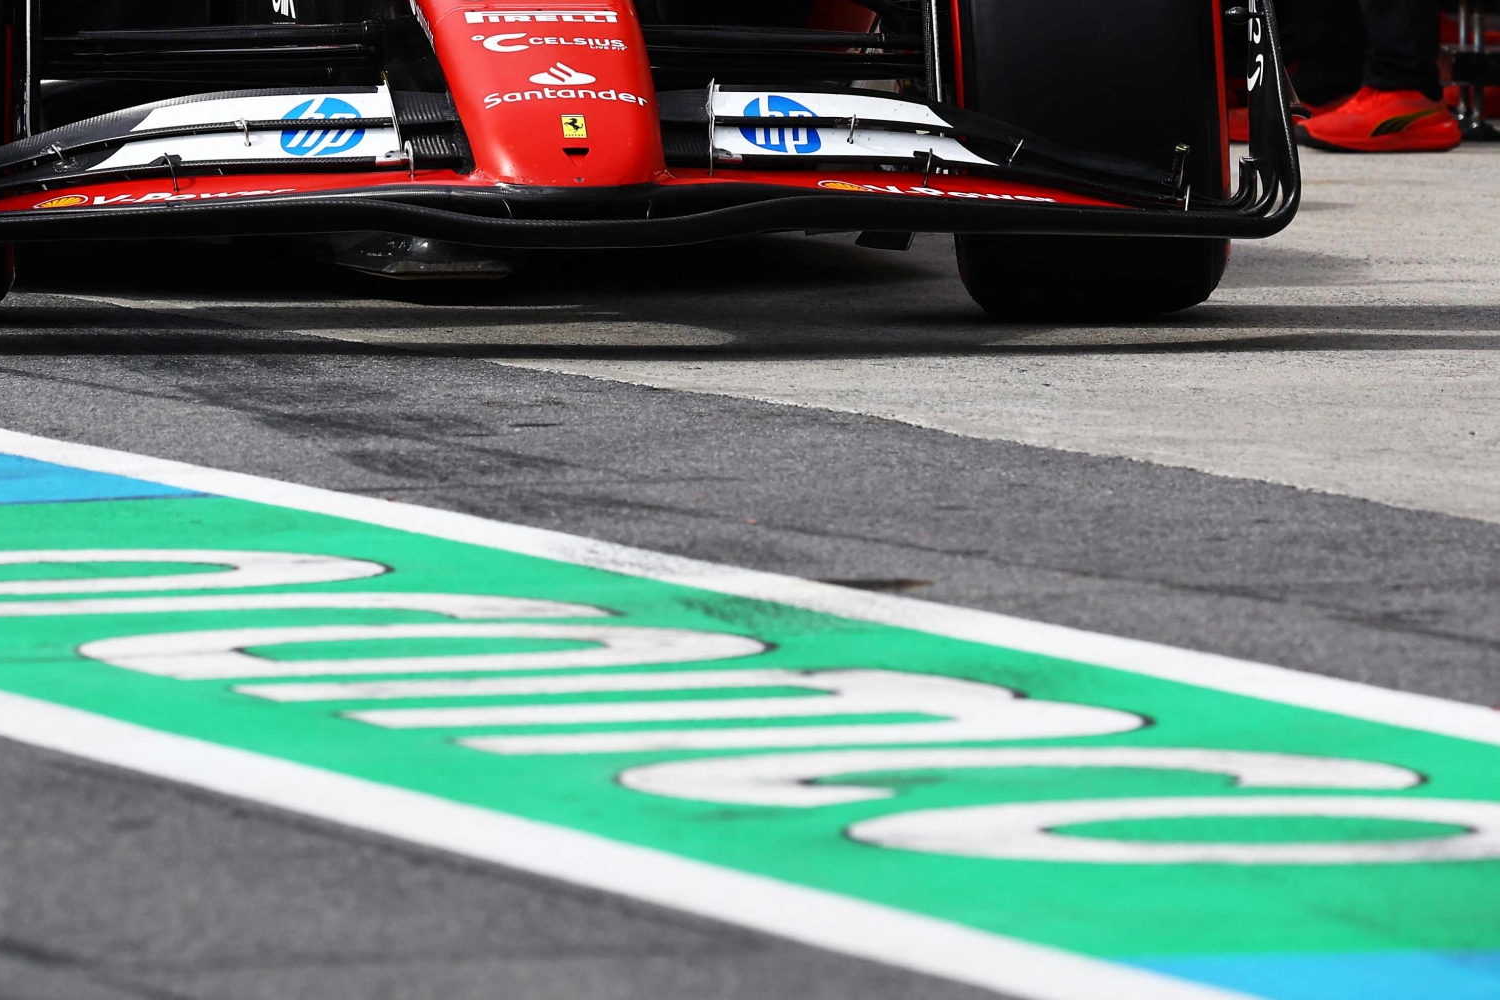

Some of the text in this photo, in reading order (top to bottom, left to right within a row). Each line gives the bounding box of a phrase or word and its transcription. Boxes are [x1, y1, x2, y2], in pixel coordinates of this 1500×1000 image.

[463, 10, 618, 24] PIRELLI
[528, 36, 625, 48] CELSIUS
[483, 87, 648, 110] Santander
[92, 188, 297, 206] V-Power
[863, 184, 1057, 203] V-Power
